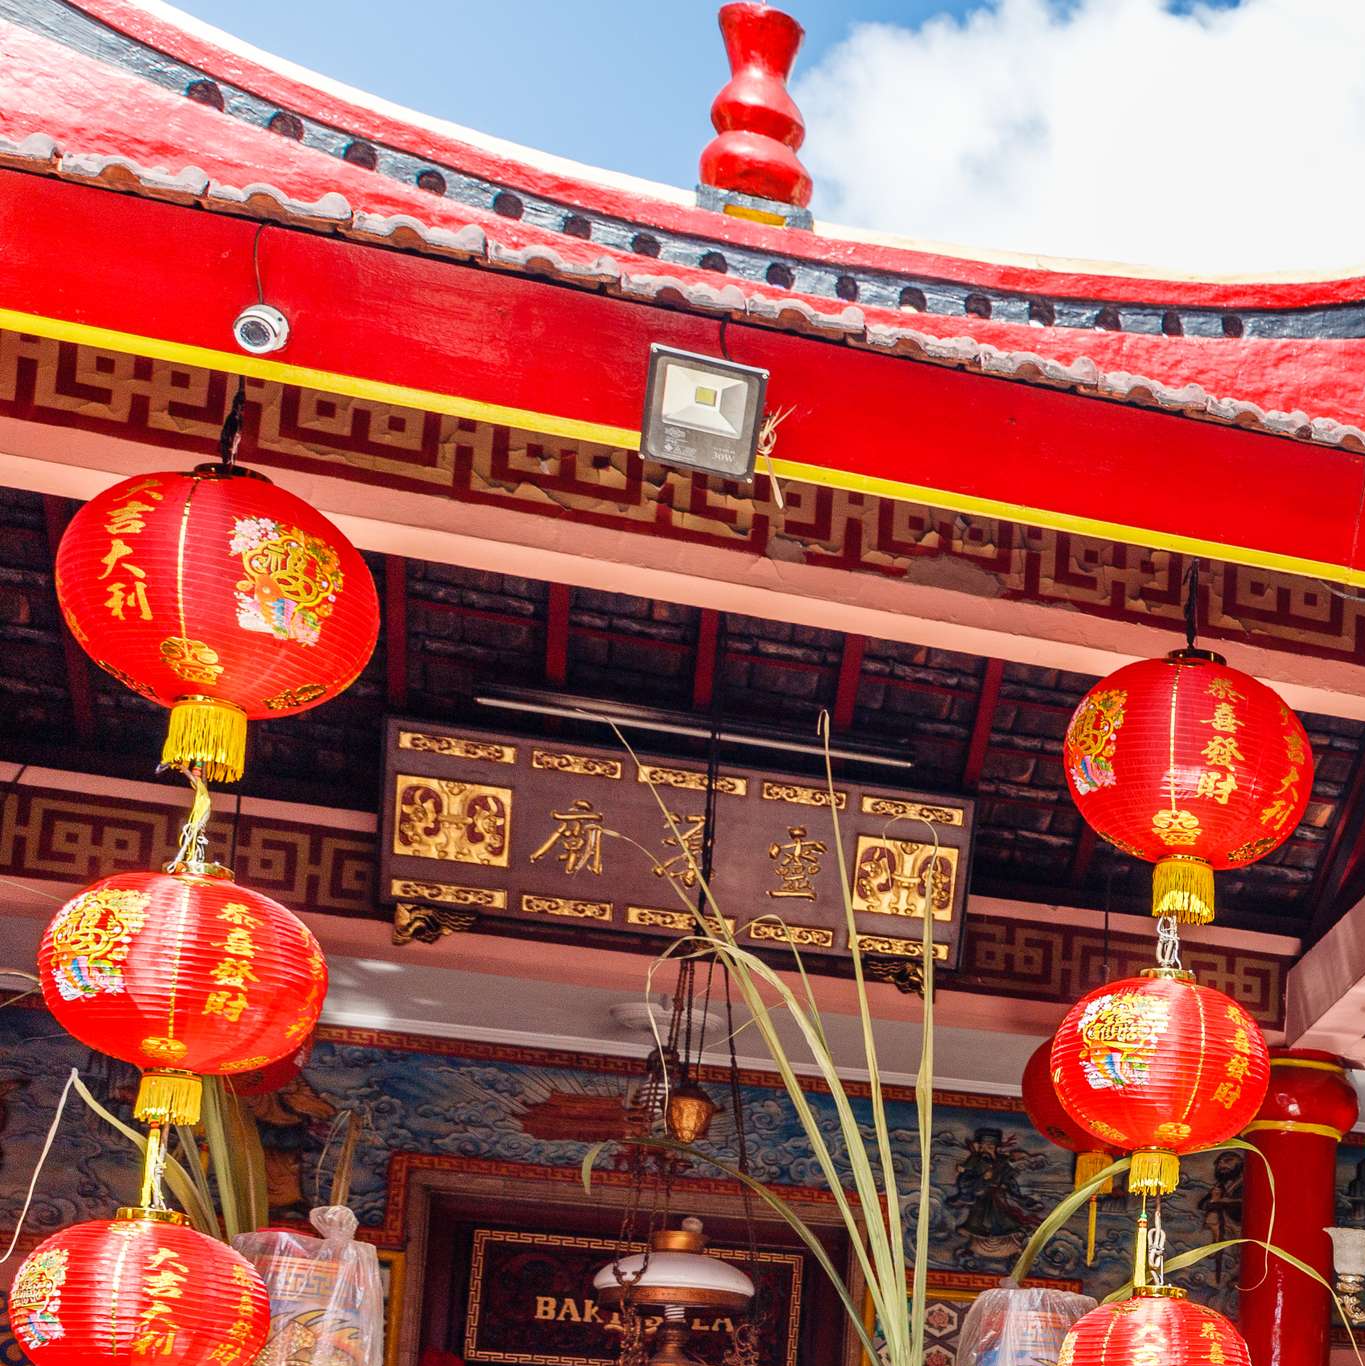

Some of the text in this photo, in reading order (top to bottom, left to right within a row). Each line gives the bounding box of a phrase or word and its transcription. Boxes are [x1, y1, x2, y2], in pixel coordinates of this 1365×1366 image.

[97, 479, 163, 621] 大吉大利
[1195, 677, 1247, 805] 恭喜發財
[202, 902, 264, 1022] 恭喜發財
[132, 1247, 189, 1356] 大吉大利
